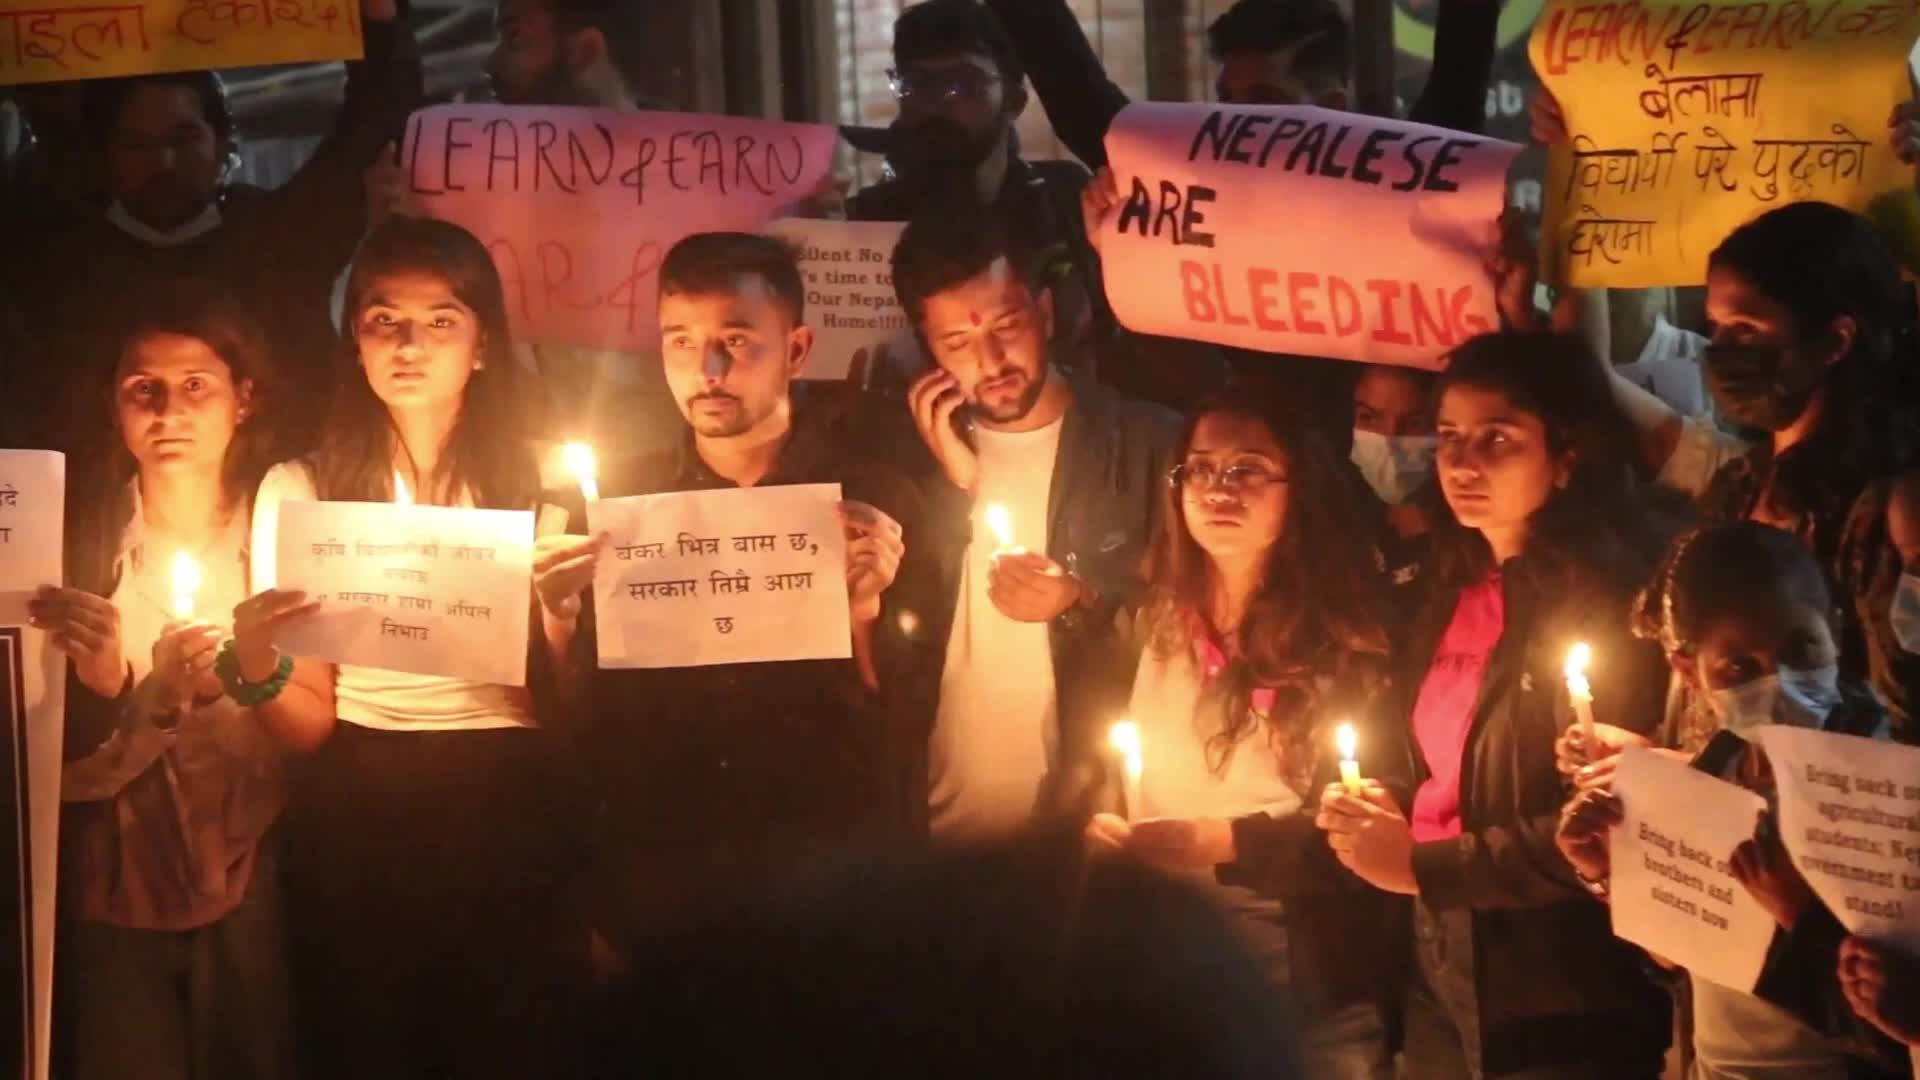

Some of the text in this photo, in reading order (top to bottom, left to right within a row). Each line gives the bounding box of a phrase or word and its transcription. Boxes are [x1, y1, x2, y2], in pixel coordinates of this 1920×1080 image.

[1544, 3, 1673, 76] LEARN
[410, 117, 615, 196] LEARN
[662, 131, 804, 197] EARN
[1189, 110, 1480, 193] NEPALESE
[1118, 176, 1217, 248] ARE
[858, 248, 883, 262] No
[488, 236, 603, 321] AR
[825, 270, 868, 285] time
[807, 291, 901, 311] Our Nepa
[1180, 259, 1490, 348] BLEEDING
[677, 532, 721, 557] भित्र
[628, 578, 698, 601] सरकार
[765, 571, 814, 592] आश
[713, 616, 735, 635] छ
[1818, 801, 1920, 832] agricultura
[1644, 851, 1734, 905] brothers and
[1800, 855, 1895, 889] overnment
